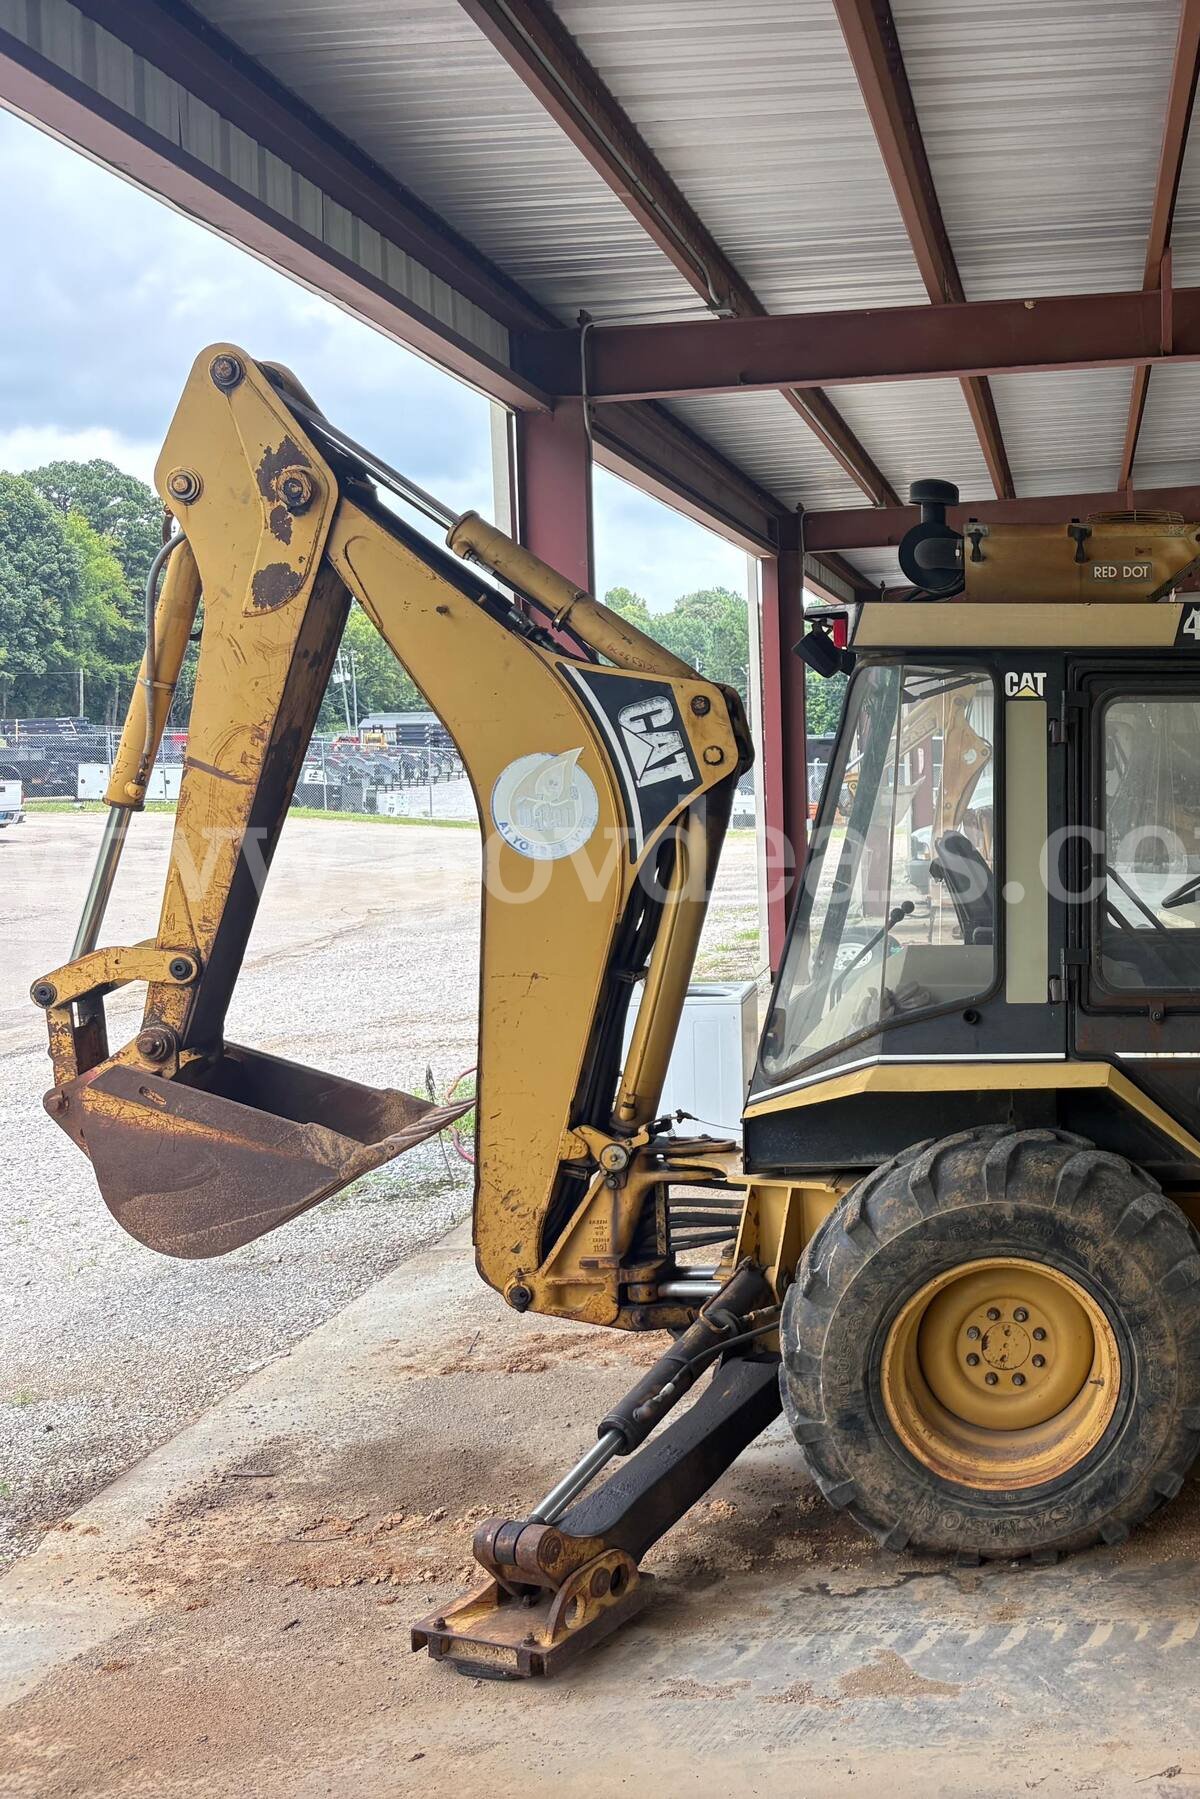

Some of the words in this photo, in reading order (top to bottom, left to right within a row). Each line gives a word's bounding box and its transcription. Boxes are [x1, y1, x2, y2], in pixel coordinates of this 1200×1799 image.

[1093, 566, 1117, 578] RED
[1123, 566, 1149, 578] DOT
[1005, 672, 1047, 697] CAT
[618, 695, 694, 789] CAT
